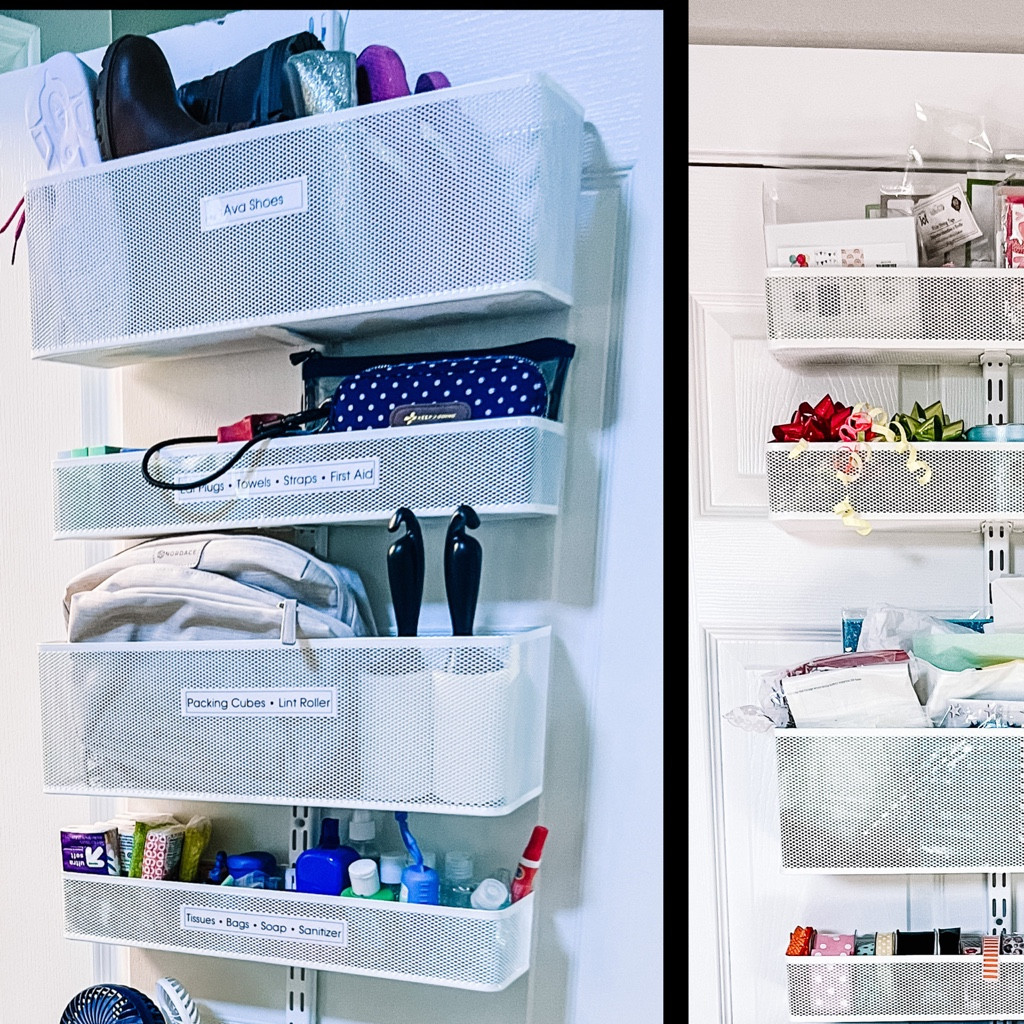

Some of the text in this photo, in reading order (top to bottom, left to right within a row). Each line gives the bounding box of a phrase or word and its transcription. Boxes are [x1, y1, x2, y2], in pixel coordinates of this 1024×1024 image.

[223, 195, 284, 216] Ava Shoes
[237, 478, 271, 490] Towels
[283, 474, 318, 486] Straps
[330, 471, 351, 483] First
[353, 468, 374, 481] Aid
[187, 697, 331, 710] Packing Cubes Lint Roller
[186, 912, 343, 939] Tissues Bags Soap Sanitizer
